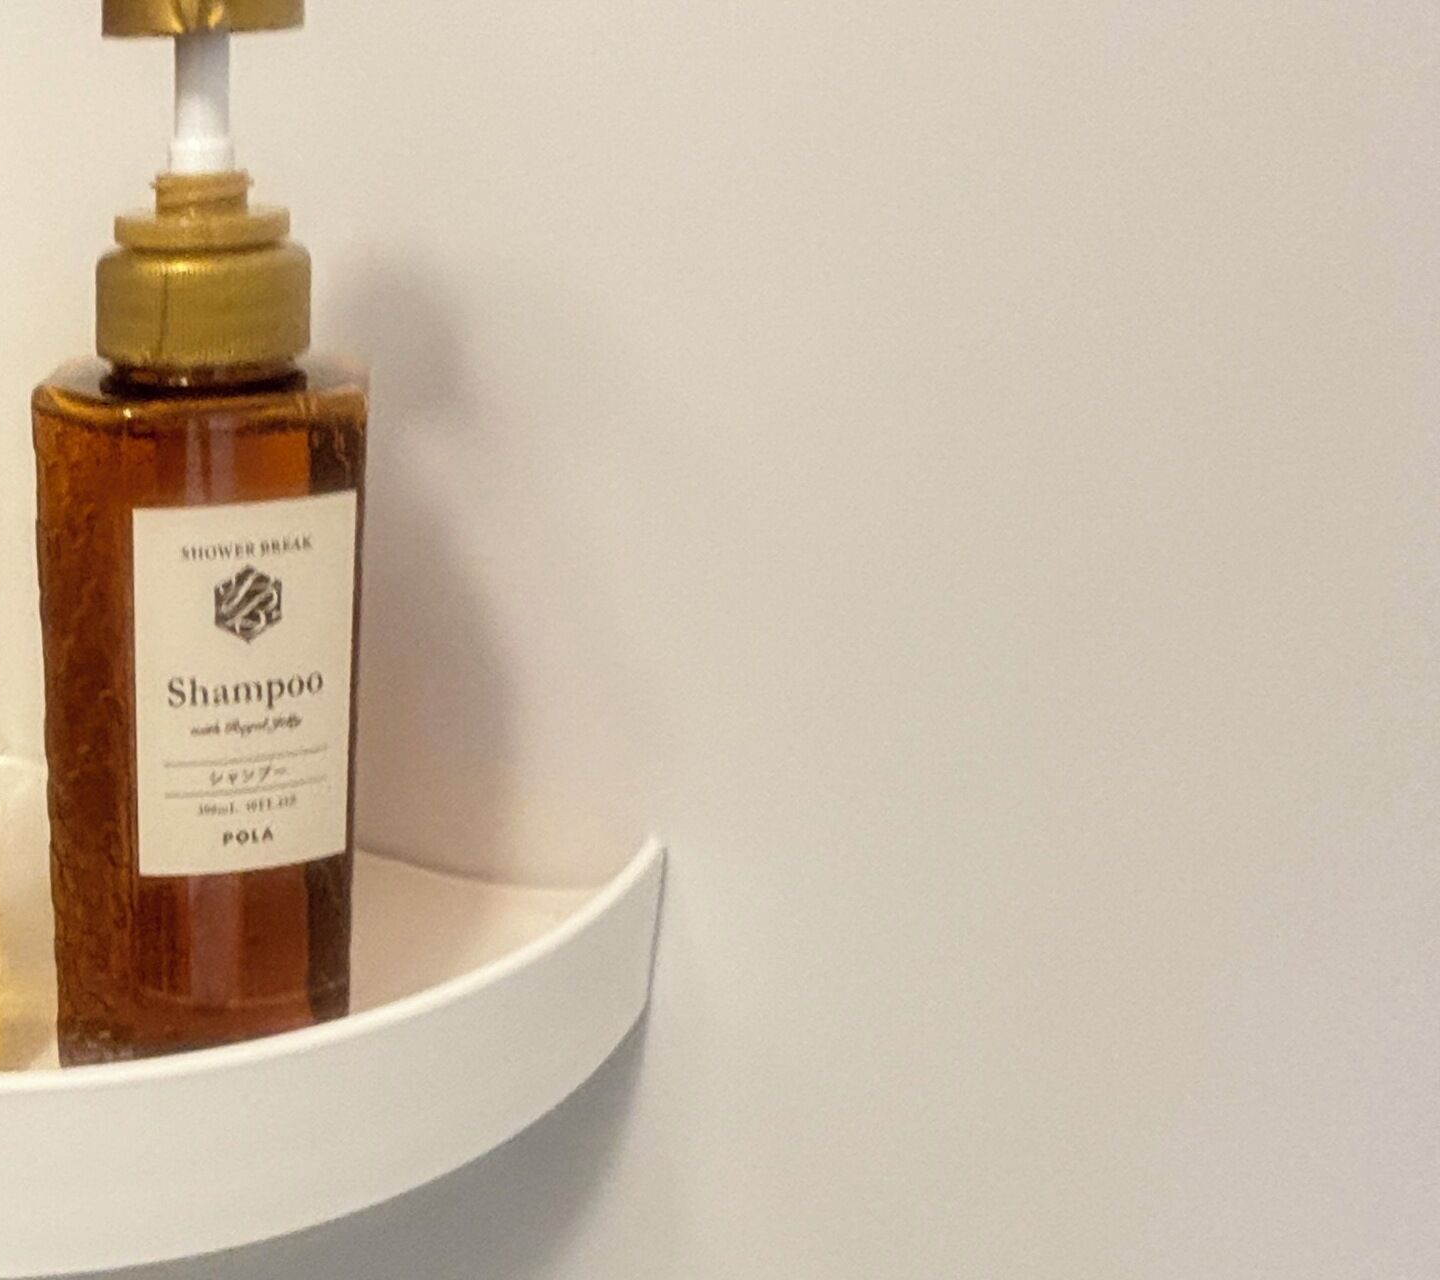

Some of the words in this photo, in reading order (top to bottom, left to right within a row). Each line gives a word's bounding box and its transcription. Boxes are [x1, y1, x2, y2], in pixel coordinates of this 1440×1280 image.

[181, 541, 255, 562] SHOWER
[259, 534, 313, 557] BREAK
[167, 670, 324, 710] Shampoo
[222, 826, 274, 847] POLA
